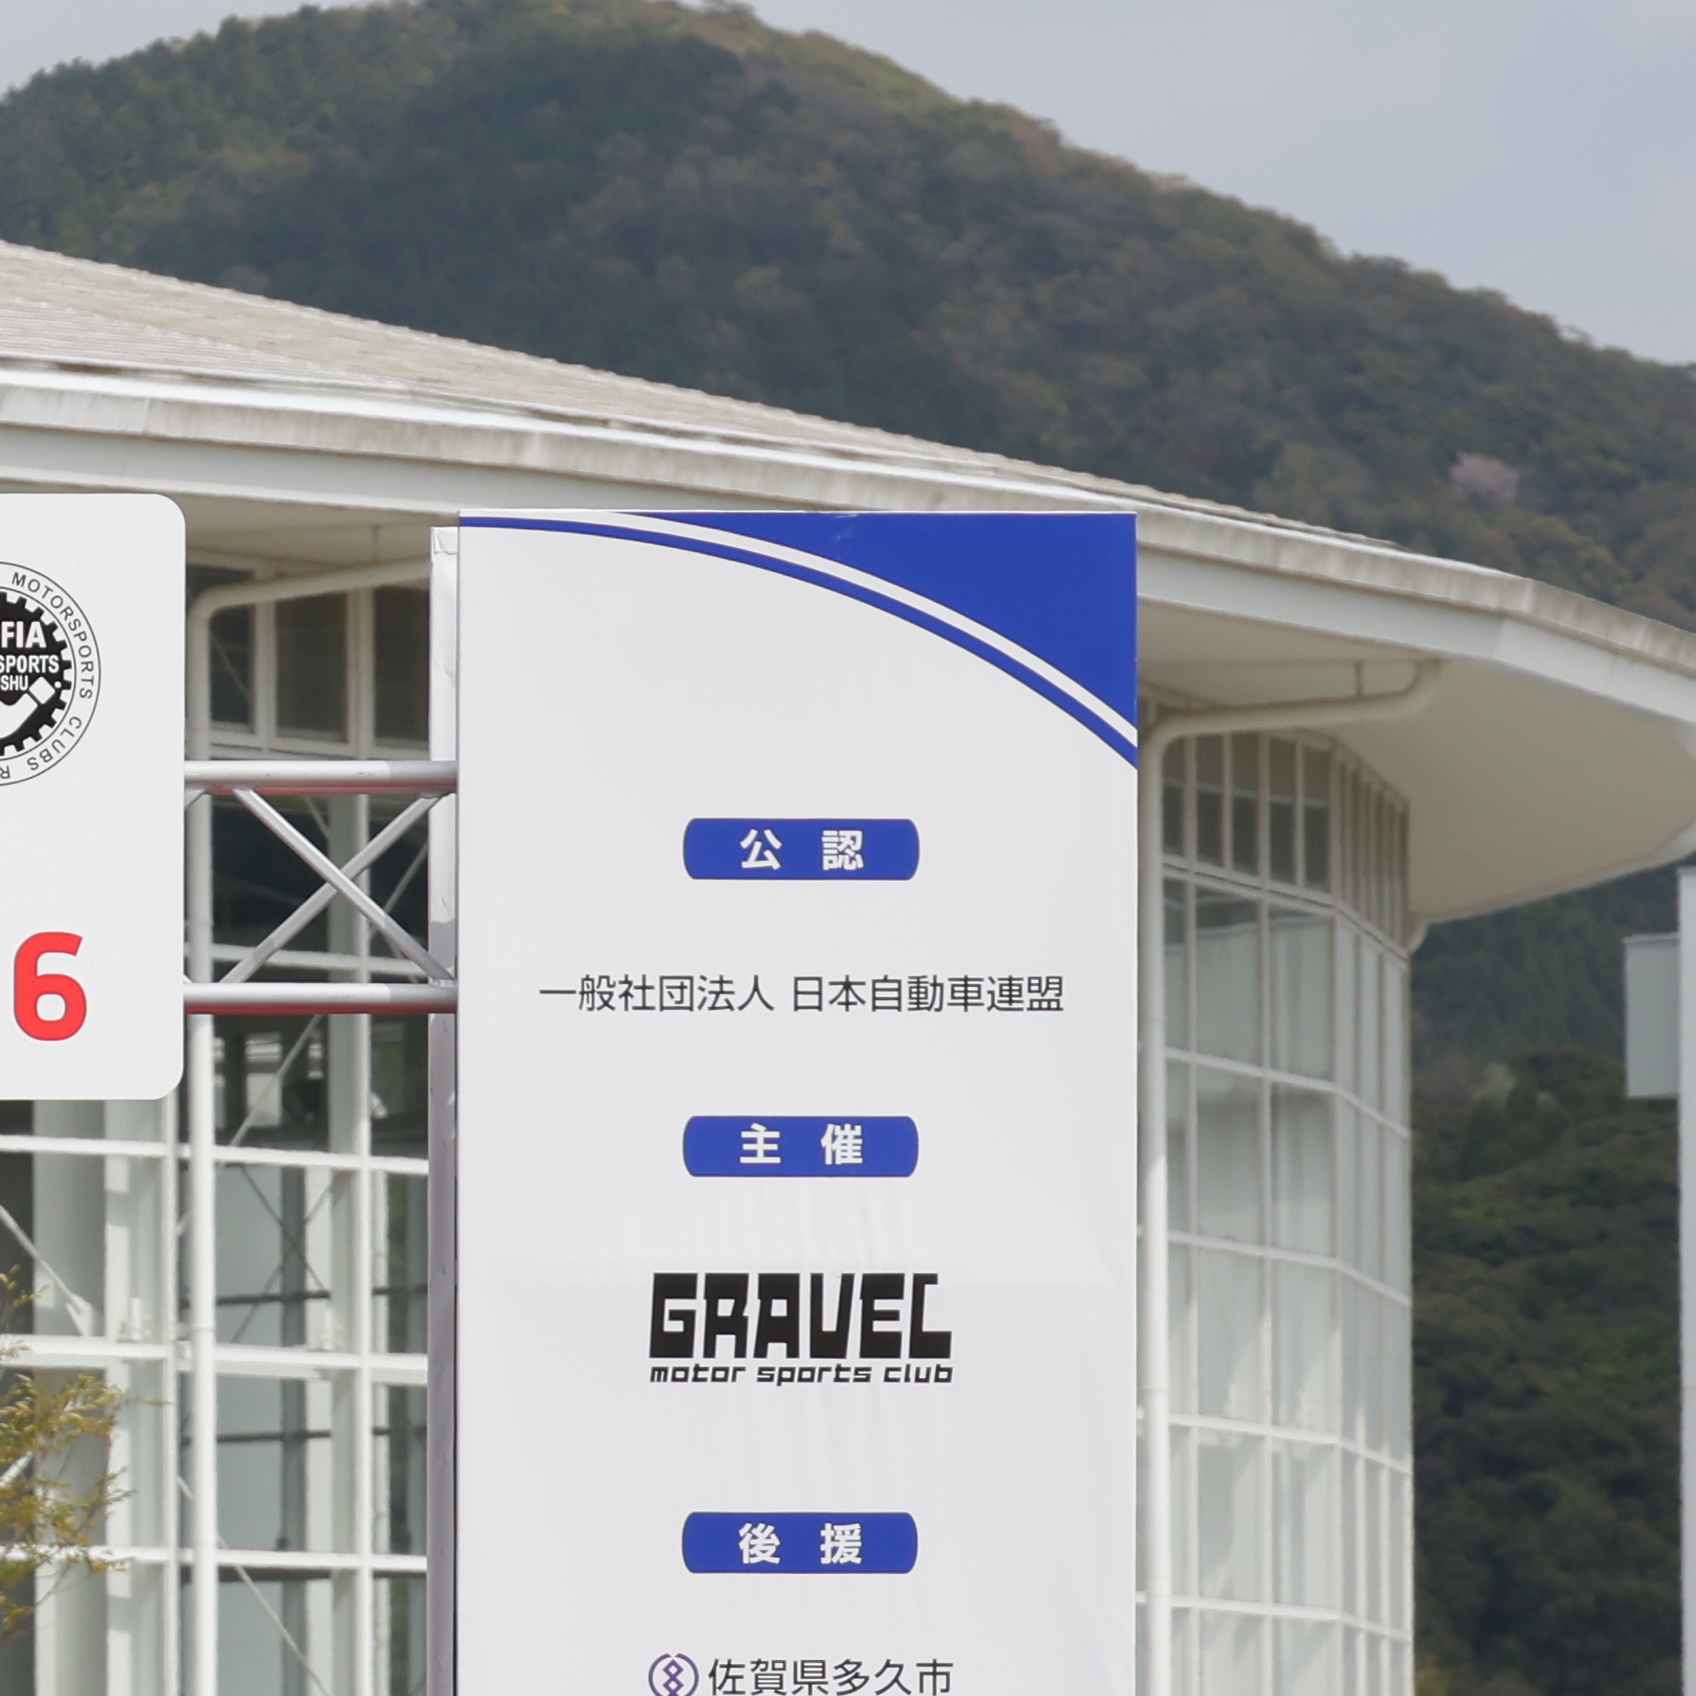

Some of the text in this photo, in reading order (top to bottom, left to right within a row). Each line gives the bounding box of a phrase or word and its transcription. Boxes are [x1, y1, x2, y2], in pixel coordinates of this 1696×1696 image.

[11, 571, 94, 699] MOTORSPORTS
[26, 716, 82, 771] CLUBS
[739, 829, 864, 871] 公認
[539, 974, 1064, 1012] 一般社団法人 日本自動車連盟
[739, 1123, 864, 1166] 主催
[649, 1272, 952, 1359] GRAVEL
[650, 1364, 953, 1387] motor sports club
[738, 1523, 863, 1565] 後援
[708, 1658, 954, 1696] 佐賀県多久市
